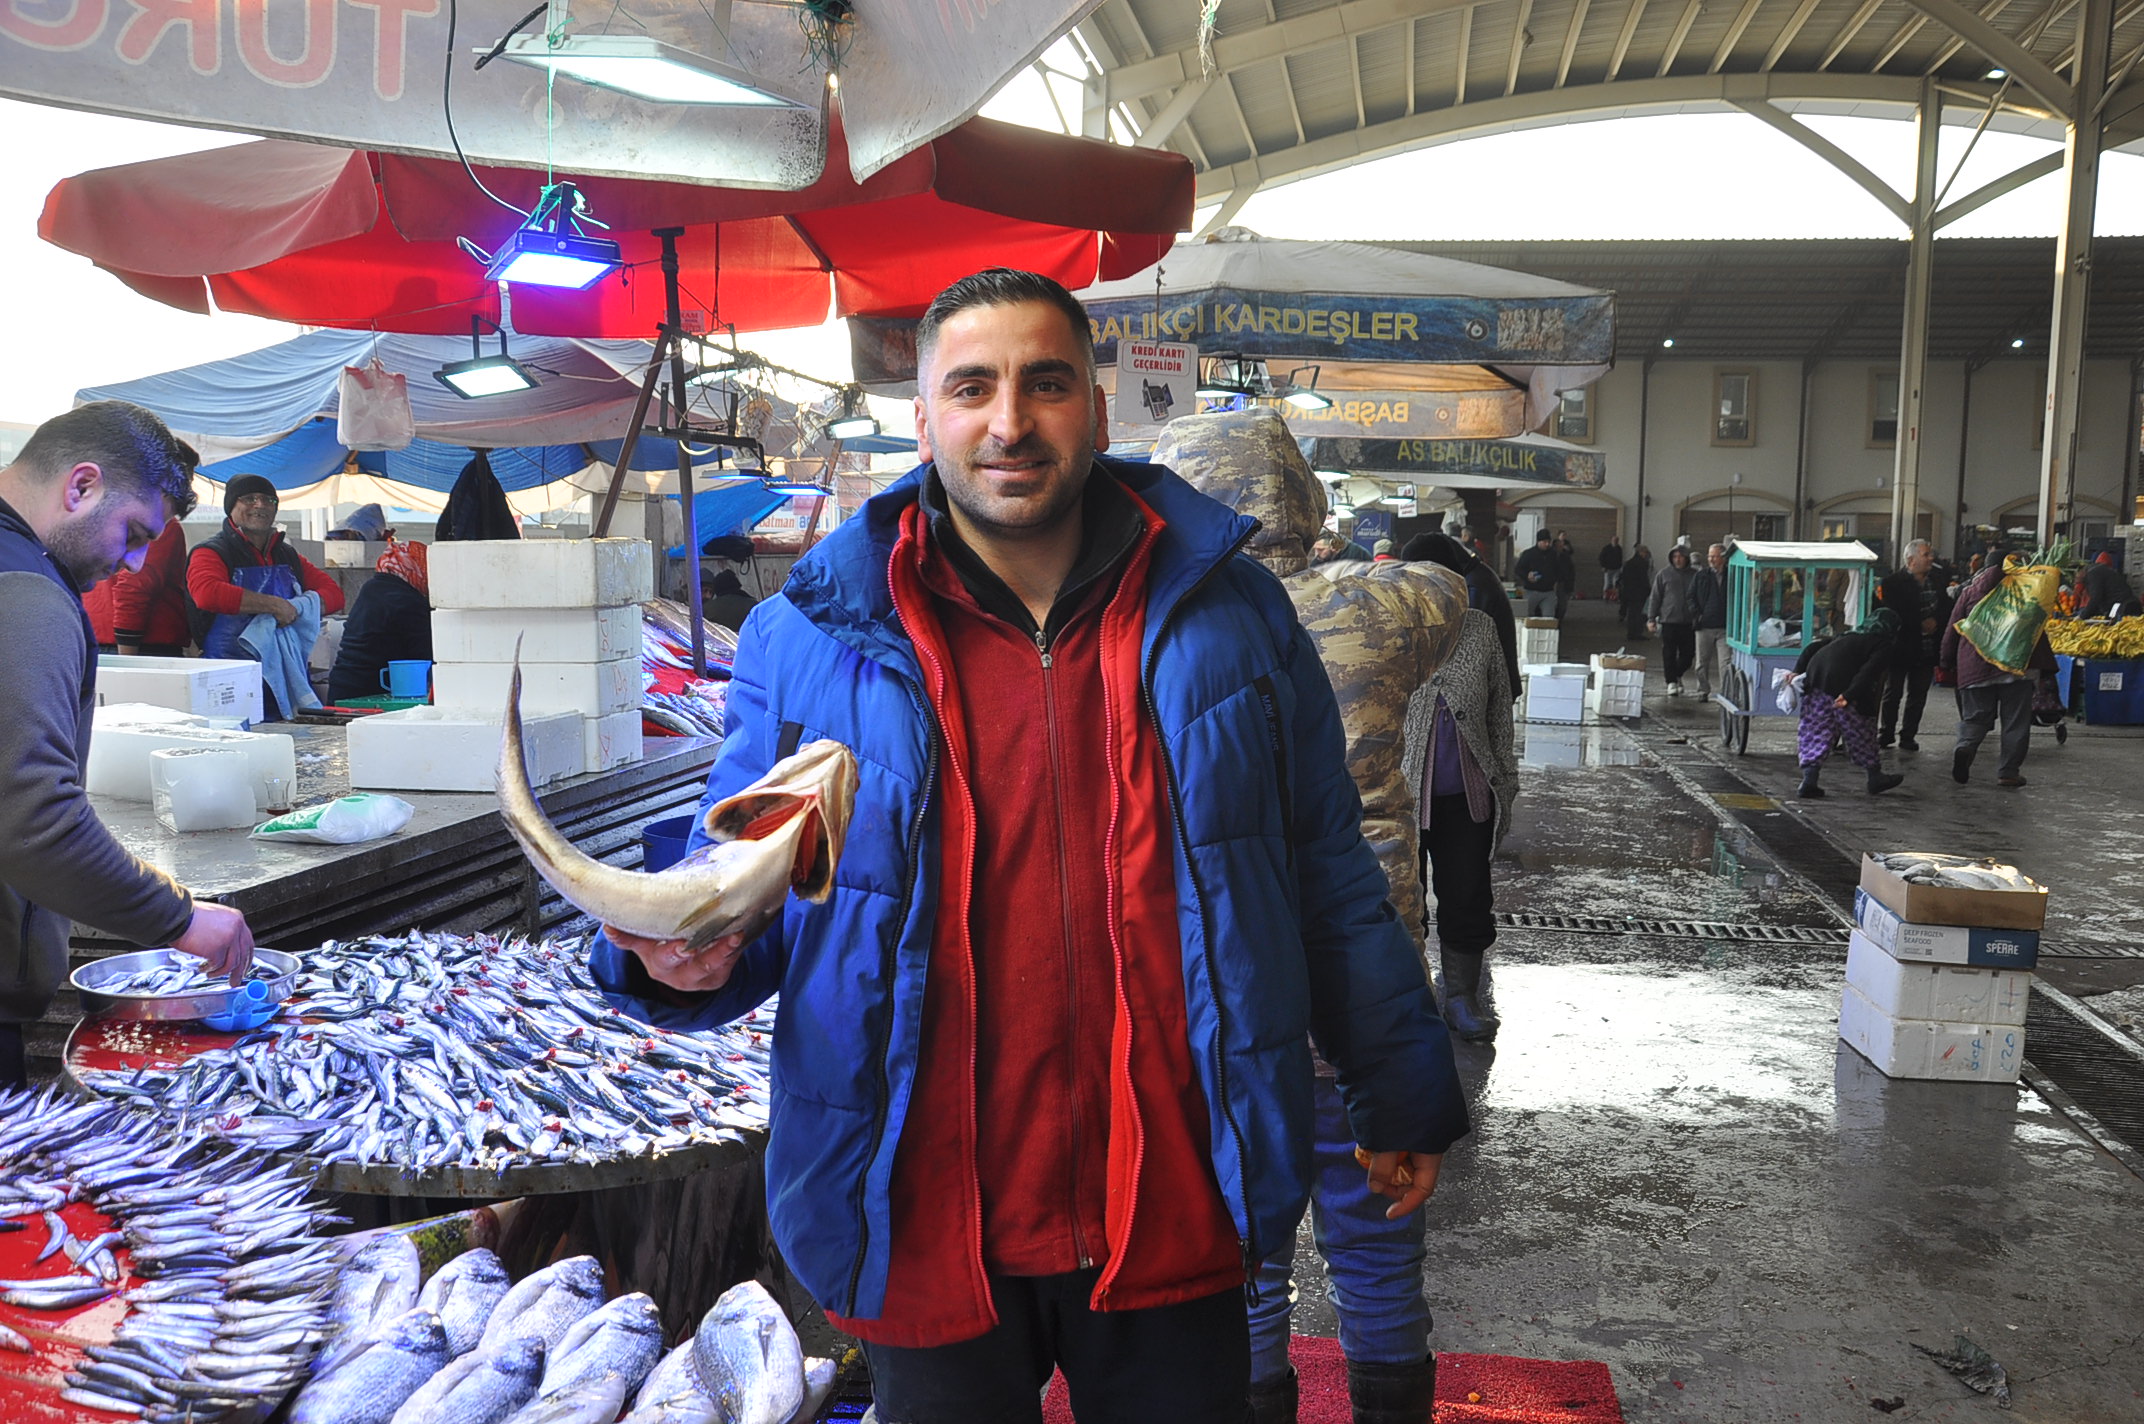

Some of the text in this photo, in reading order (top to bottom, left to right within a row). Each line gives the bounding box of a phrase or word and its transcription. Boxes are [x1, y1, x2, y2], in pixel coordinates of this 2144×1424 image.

[1215, 303, 1420, 344] KARDEŞLER
[1159, 347, 1185, 359] KARTI
[1133, 359, 1182, 372] GEÇERLİDİR
[1397, 440, 1537, 472] AS BALIKÇILIK
[1904, 936, 1932, 945] SEAFOOD
[1920, 930, 1944, 938] FROZEN
[1985, 943, 2020, 956] SPERRE
